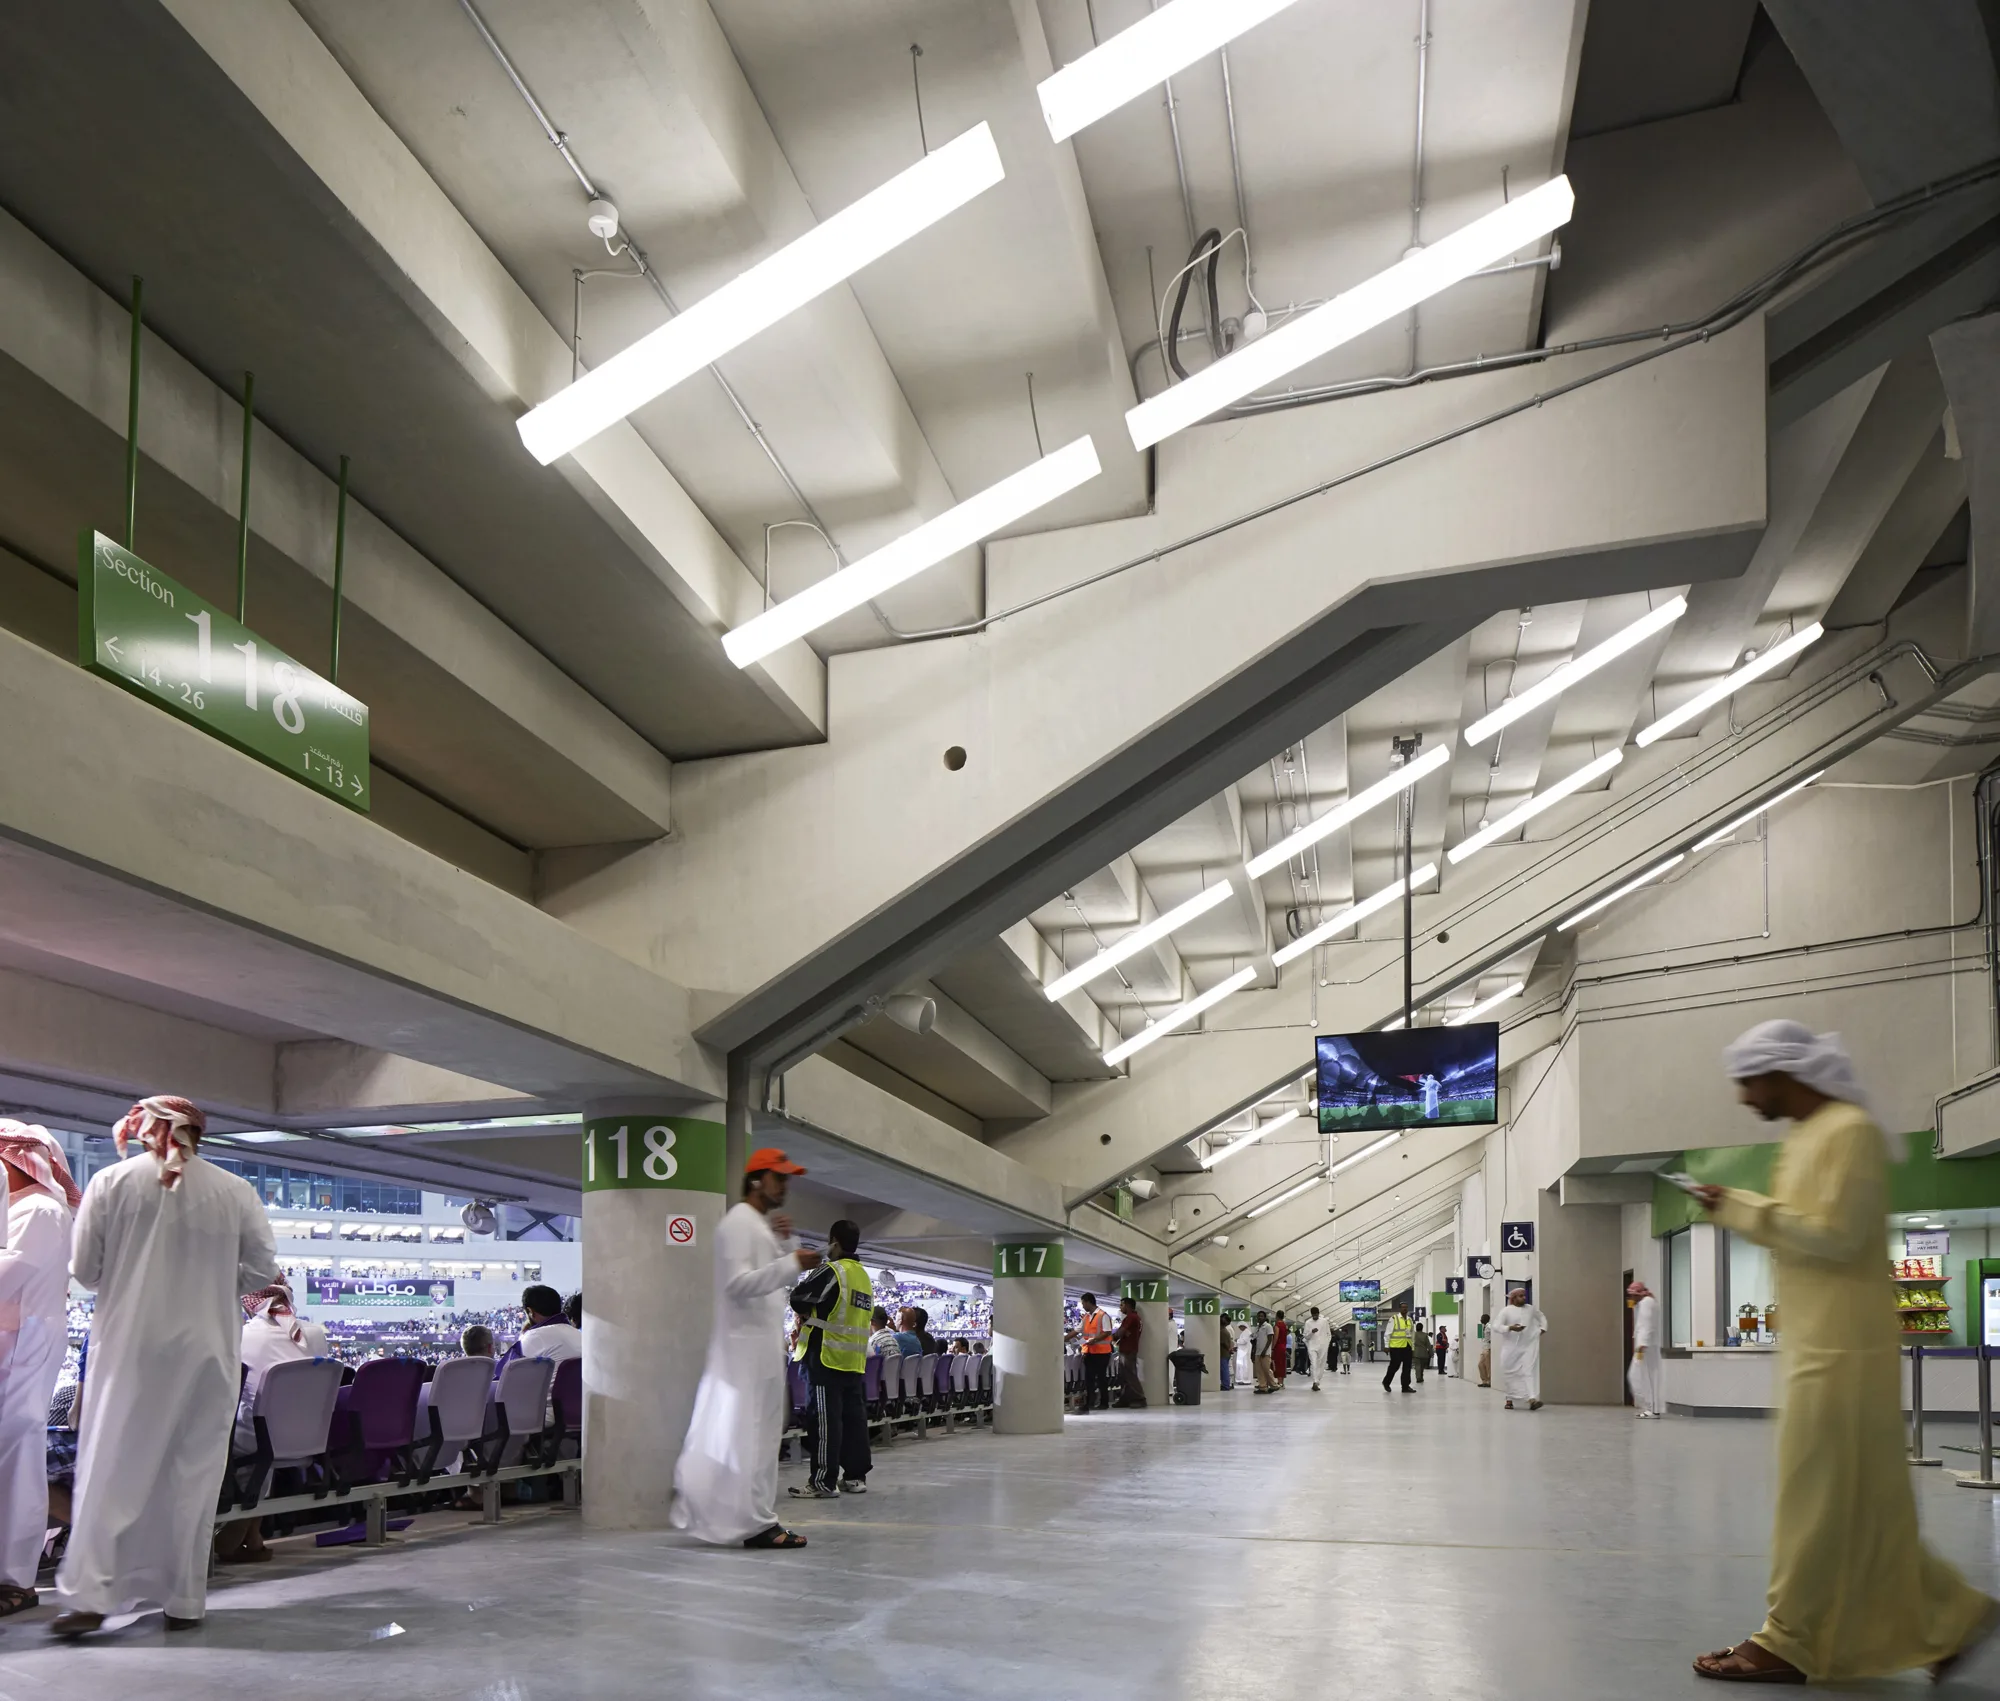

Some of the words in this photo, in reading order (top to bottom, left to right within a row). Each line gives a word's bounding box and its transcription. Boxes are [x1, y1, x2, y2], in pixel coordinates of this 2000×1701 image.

[102, 546, 175, 608] Section
[140, 657, 162, 687] 14
[181, 682, 205, 710] 26
[184, 609, 306, 735] 118
[302, 752, 309, 770] 1
[326, 765, 344, 788] 13
[584, 1125, 678, 1182] 118
[998, 1247, 1048, 1274] 117
[1125, 1282, 1159, 1300] 117
[1188, 1300, 1214, 1314] 116
